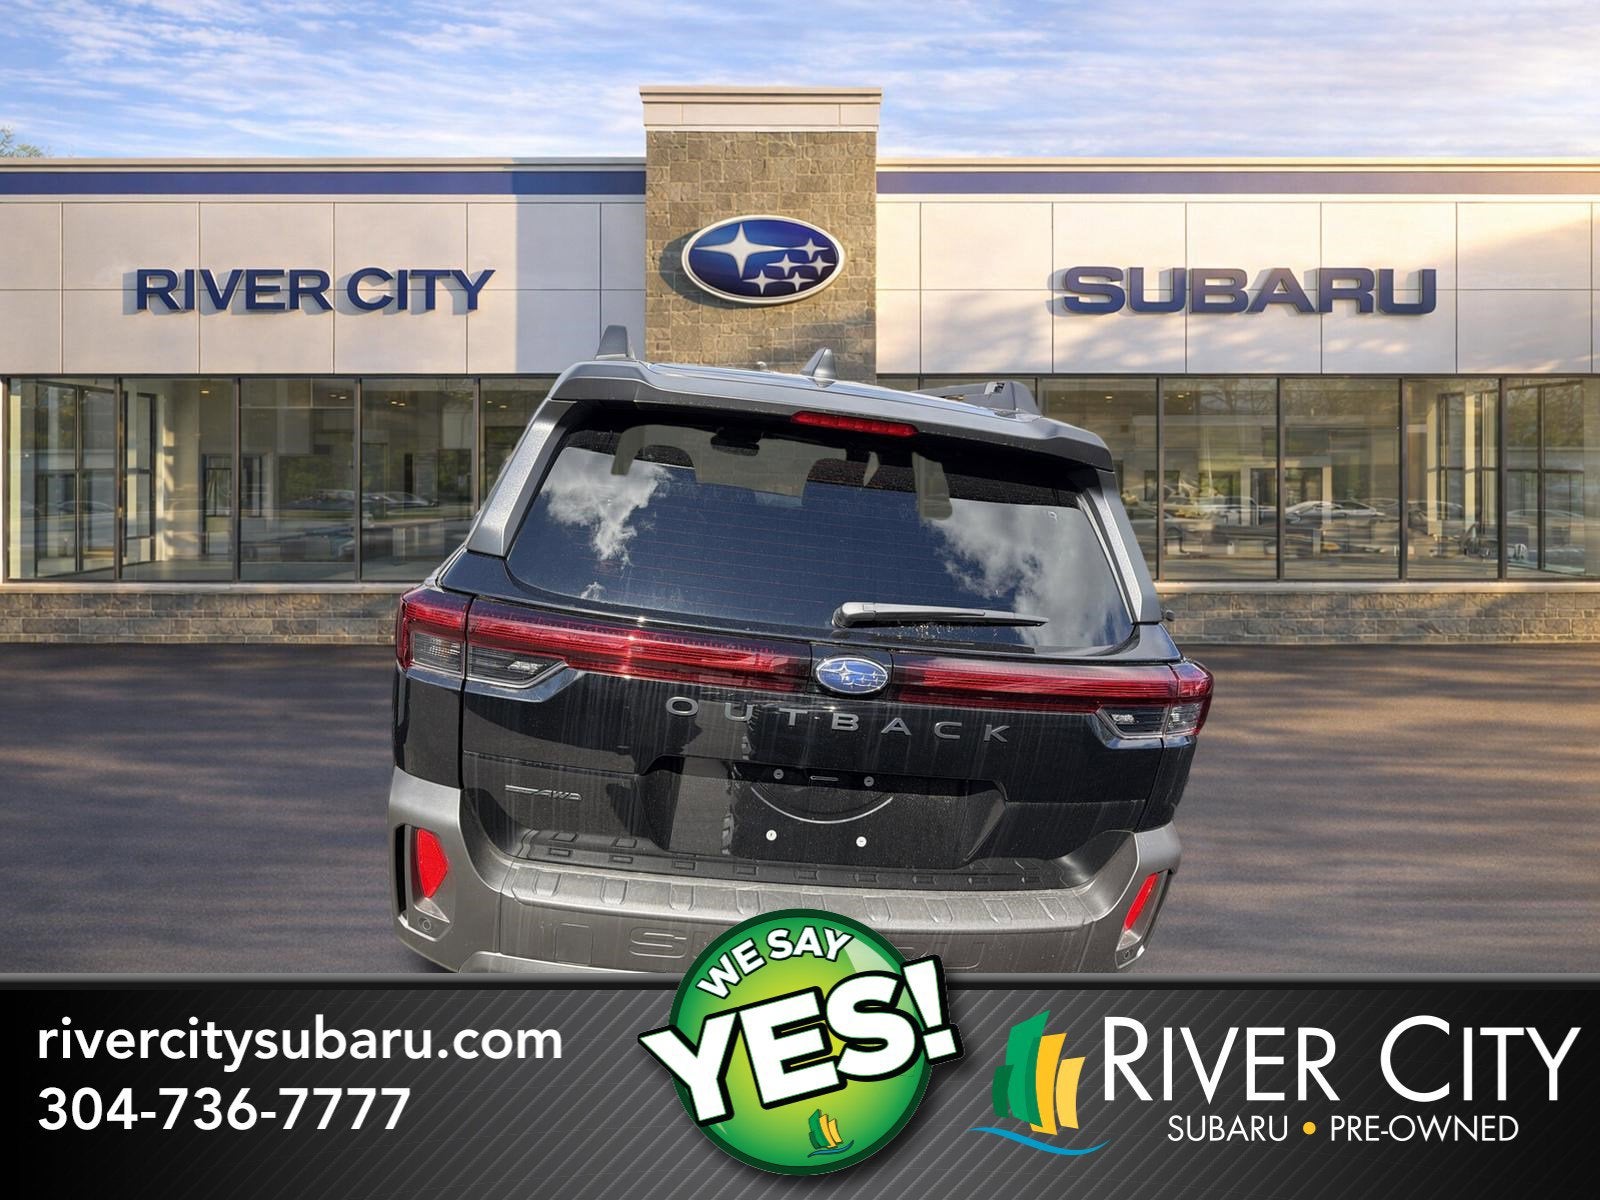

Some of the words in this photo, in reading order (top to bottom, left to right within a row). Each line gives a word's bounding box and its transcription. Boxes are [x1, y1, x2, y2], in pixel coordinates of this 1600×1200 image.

[136, 268, 335, 312] RIVER
[346, 266, 497, 312] CITY
[1062, 265, 1438, 315] SUBARU
[665, 696, 1011, 743] OUTBACK
[533, 788, 582, 801] AWD
